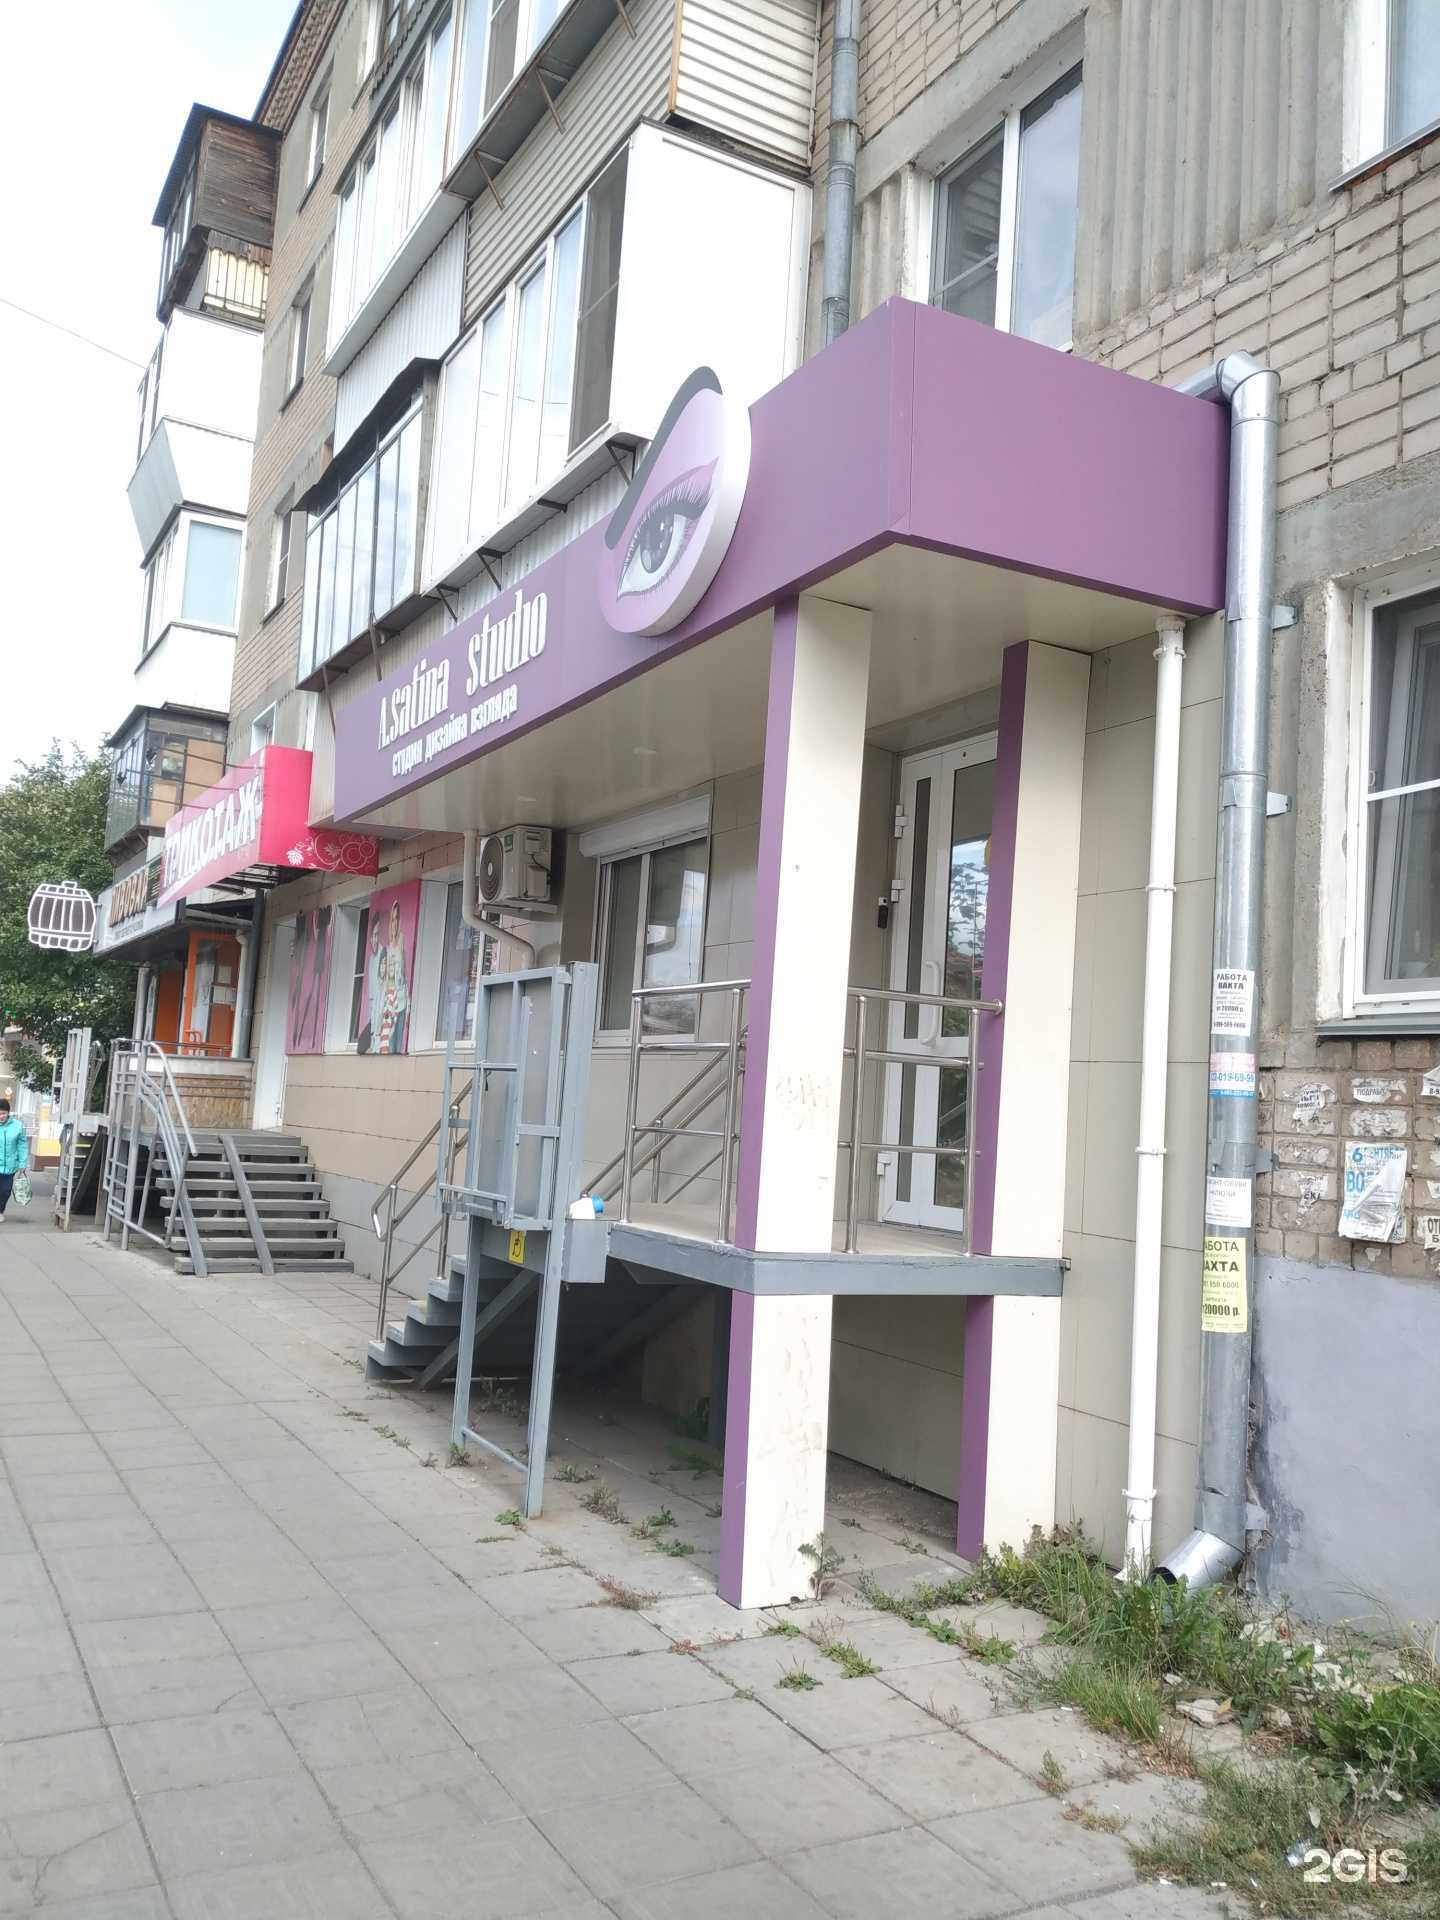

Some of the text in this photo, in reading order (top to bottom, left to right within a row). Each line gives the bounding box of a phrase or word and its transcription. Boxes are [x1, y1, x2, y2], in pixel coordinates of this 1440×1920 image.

[424, 712, 468, 764] дизайна
[469, 684, 518, 735] взгляда
[163, 774, 260, 888] ТРИКОТАЖ
[1216, 973, 1248, 982] РАБОТА
[1352, 1147, 1363, 1163] 6
